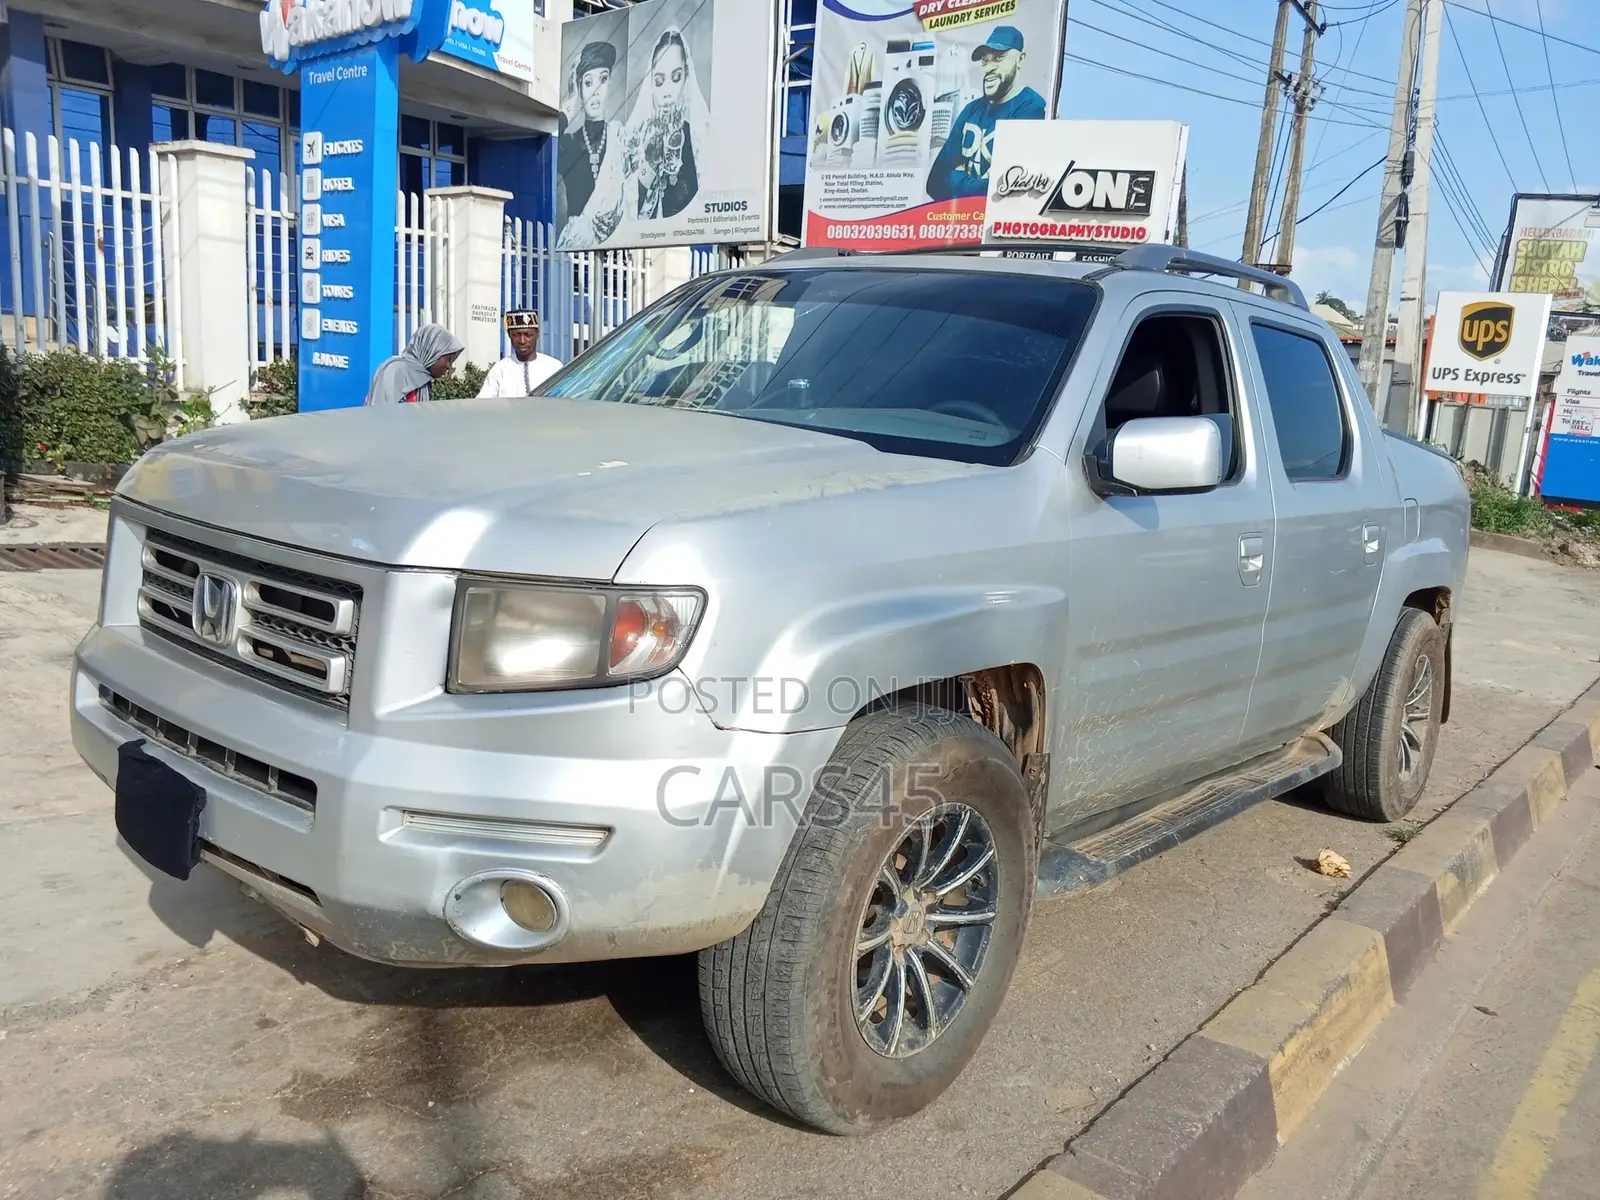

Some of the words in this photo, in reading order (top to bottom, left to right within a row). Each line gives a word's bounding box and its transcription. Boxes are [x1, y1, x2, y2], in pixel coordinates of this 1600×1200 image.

[919, 0, 945, 17] DRY
[928, 10, 973, 30] LAUNDRY
[974, 1, 1016, 20] SERVICES
[497, 54, 514, 67] Travel
[514, 60, 532, 73] Centre
[308, 69, 335, 85] Travel
[336, 64, 368, 80] Centre
[323, 139, 363, 156] FLIGHTS
[323, 177, 354, 192] HOTEL
[704, 200, 748, 213] STUDIOS
[322, 213, 345, 227] VISA
[927, 211, 971, 221] Customer
[1520, 227, 1549, 238] HELLO
[322, 249, 350, 263] RIDES
[1517, 240, 1585, 259] SOOYAH
[1513, 258, 1573, 277] BISTRO
[321, 284, 354, 299] TOURS
[1510, 276, 1526, 292] IS
[321, 318, 358, 334] EVENTS
[1462, 319, 1509, 351] ups
[1431, 366, 1460, 381] UPS
[1566, 388, 1591, 396] Flights
